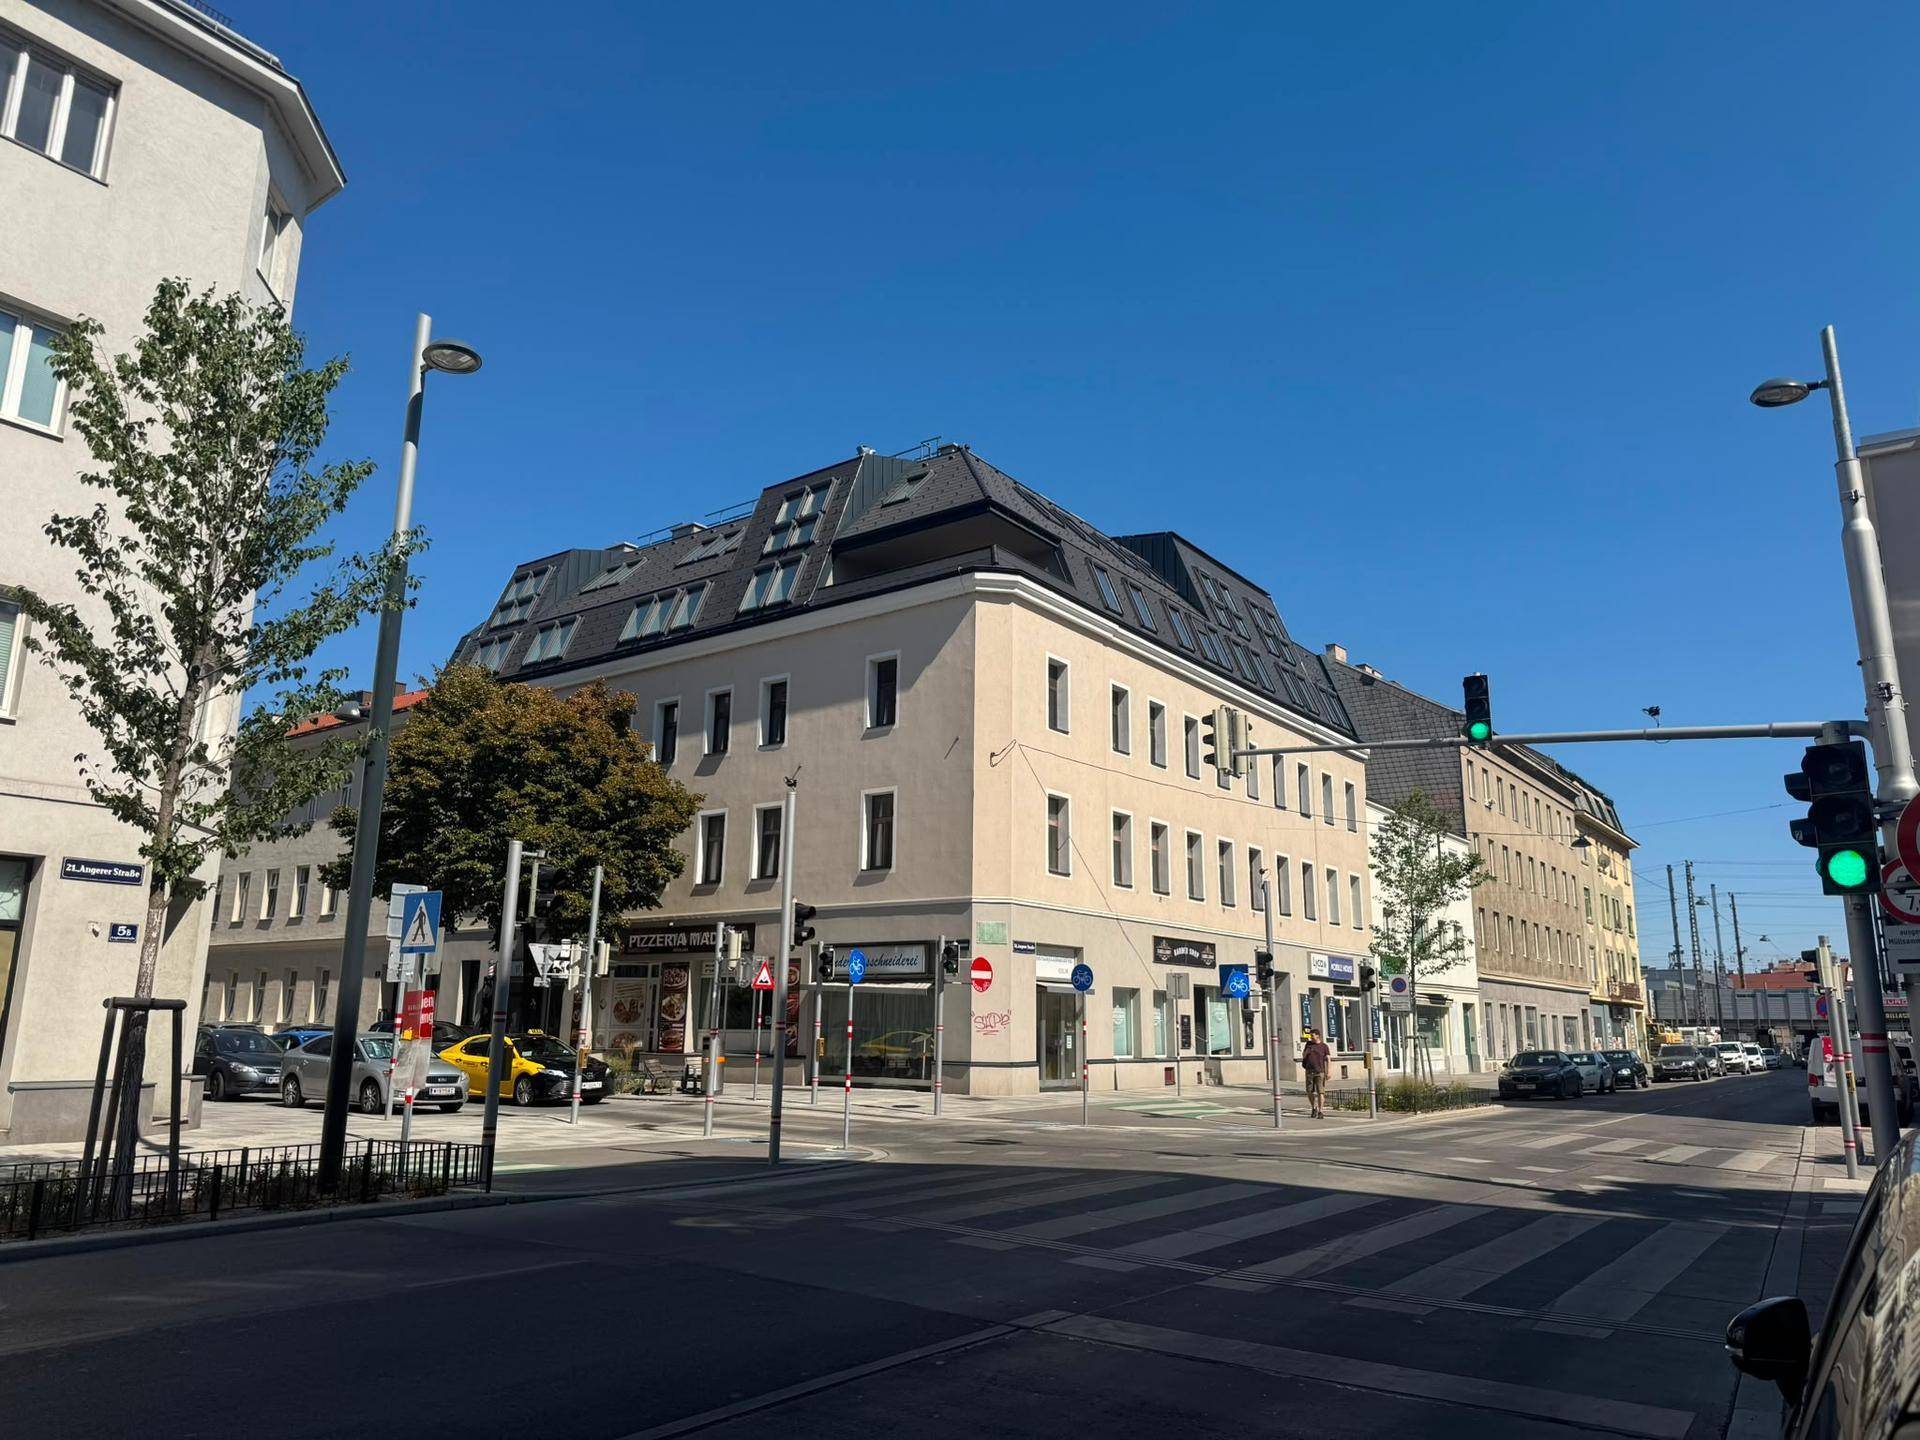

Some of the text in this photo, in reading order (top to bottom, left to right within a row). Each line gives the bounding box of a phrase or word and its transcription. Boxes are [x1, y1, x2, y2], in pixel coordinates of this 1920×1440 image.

[79, 864, 112, 876] Angerer
[113, 868, 140, 878] Straße
[629, 932, 688, 948] PIZZERIA
